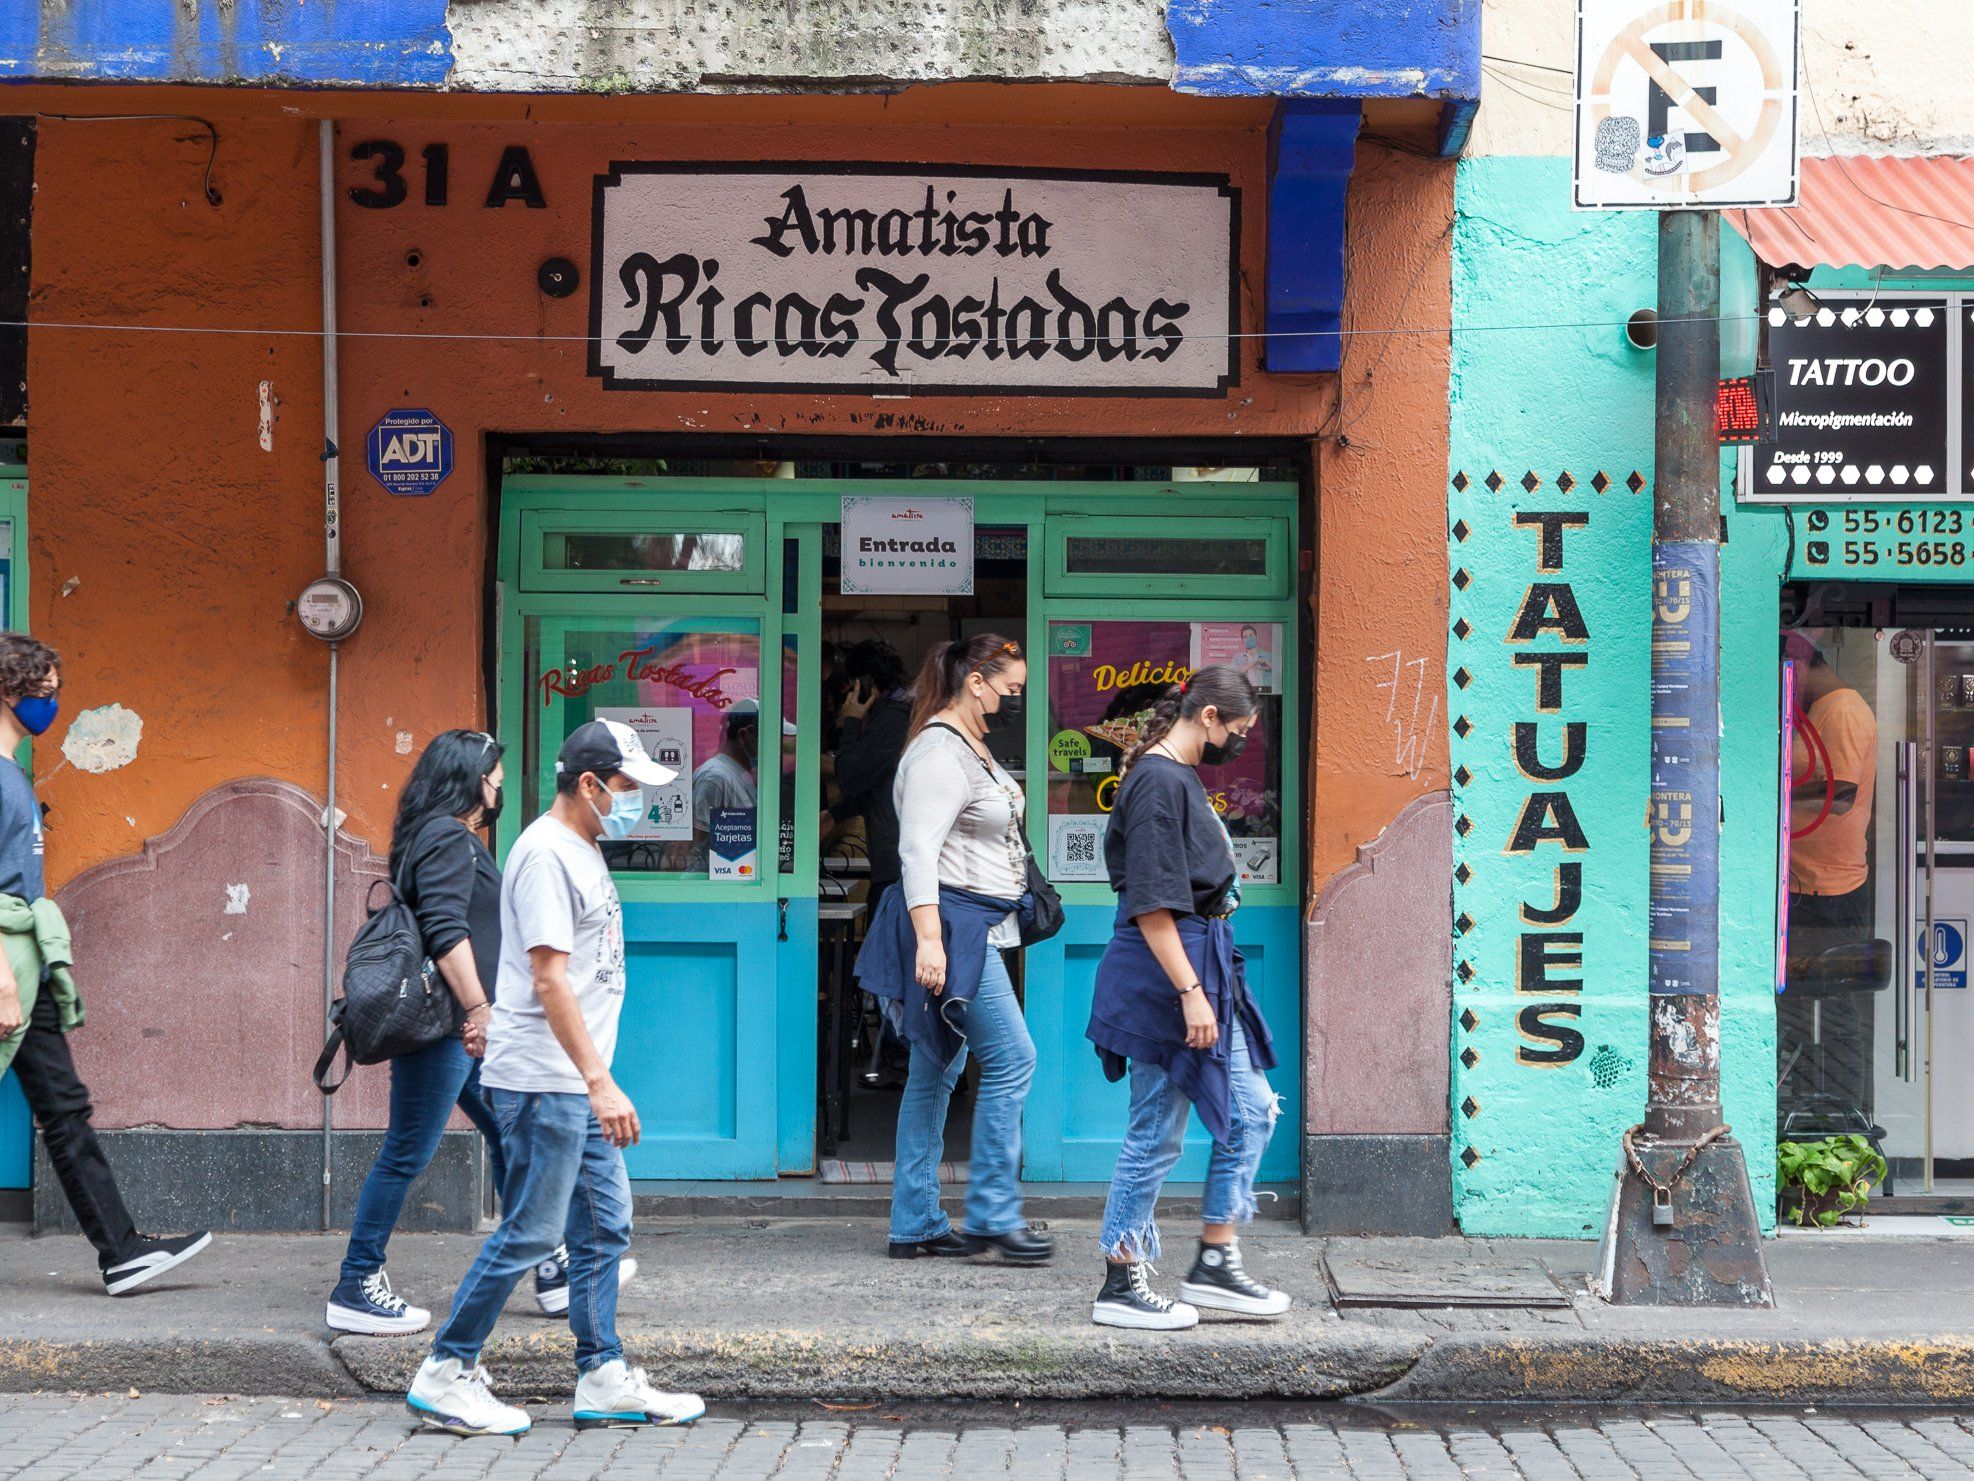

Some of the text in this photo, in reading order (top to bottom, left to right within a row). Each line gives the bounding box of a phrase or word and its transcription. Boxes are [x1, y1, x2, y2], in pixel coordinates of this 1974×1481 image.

[348, 139, 547, 209] 31 A
[749, 184, 1054, 258] Amatista
[616, 251, 1190, 377] Ricas Tostadas
[1788, 358, 1915, 387] TATTOO
[385, 418, 434, 426] Protegido por
[1778, 411, 1914, 430] Micropigmentación
[381, 433, 440, 464] ADT
[1773, 451, 1844, 464] Desde 1999
[859, 537, 957, 554] Entrada
[858, 558, 957, 568] bienvenido
[538, 646, 737, 710] Ricas Tostadas
[1058, 739, 1080, 748] Safe
[1053, 748, 1087, 757] travels
[1505, 511, 1591, 1068] TATUAJES
[715, 824, 752, 832] Aceptamos
[715, 832, 752, 843] Tarjetas
[714, 867, 731, 875] VISA
